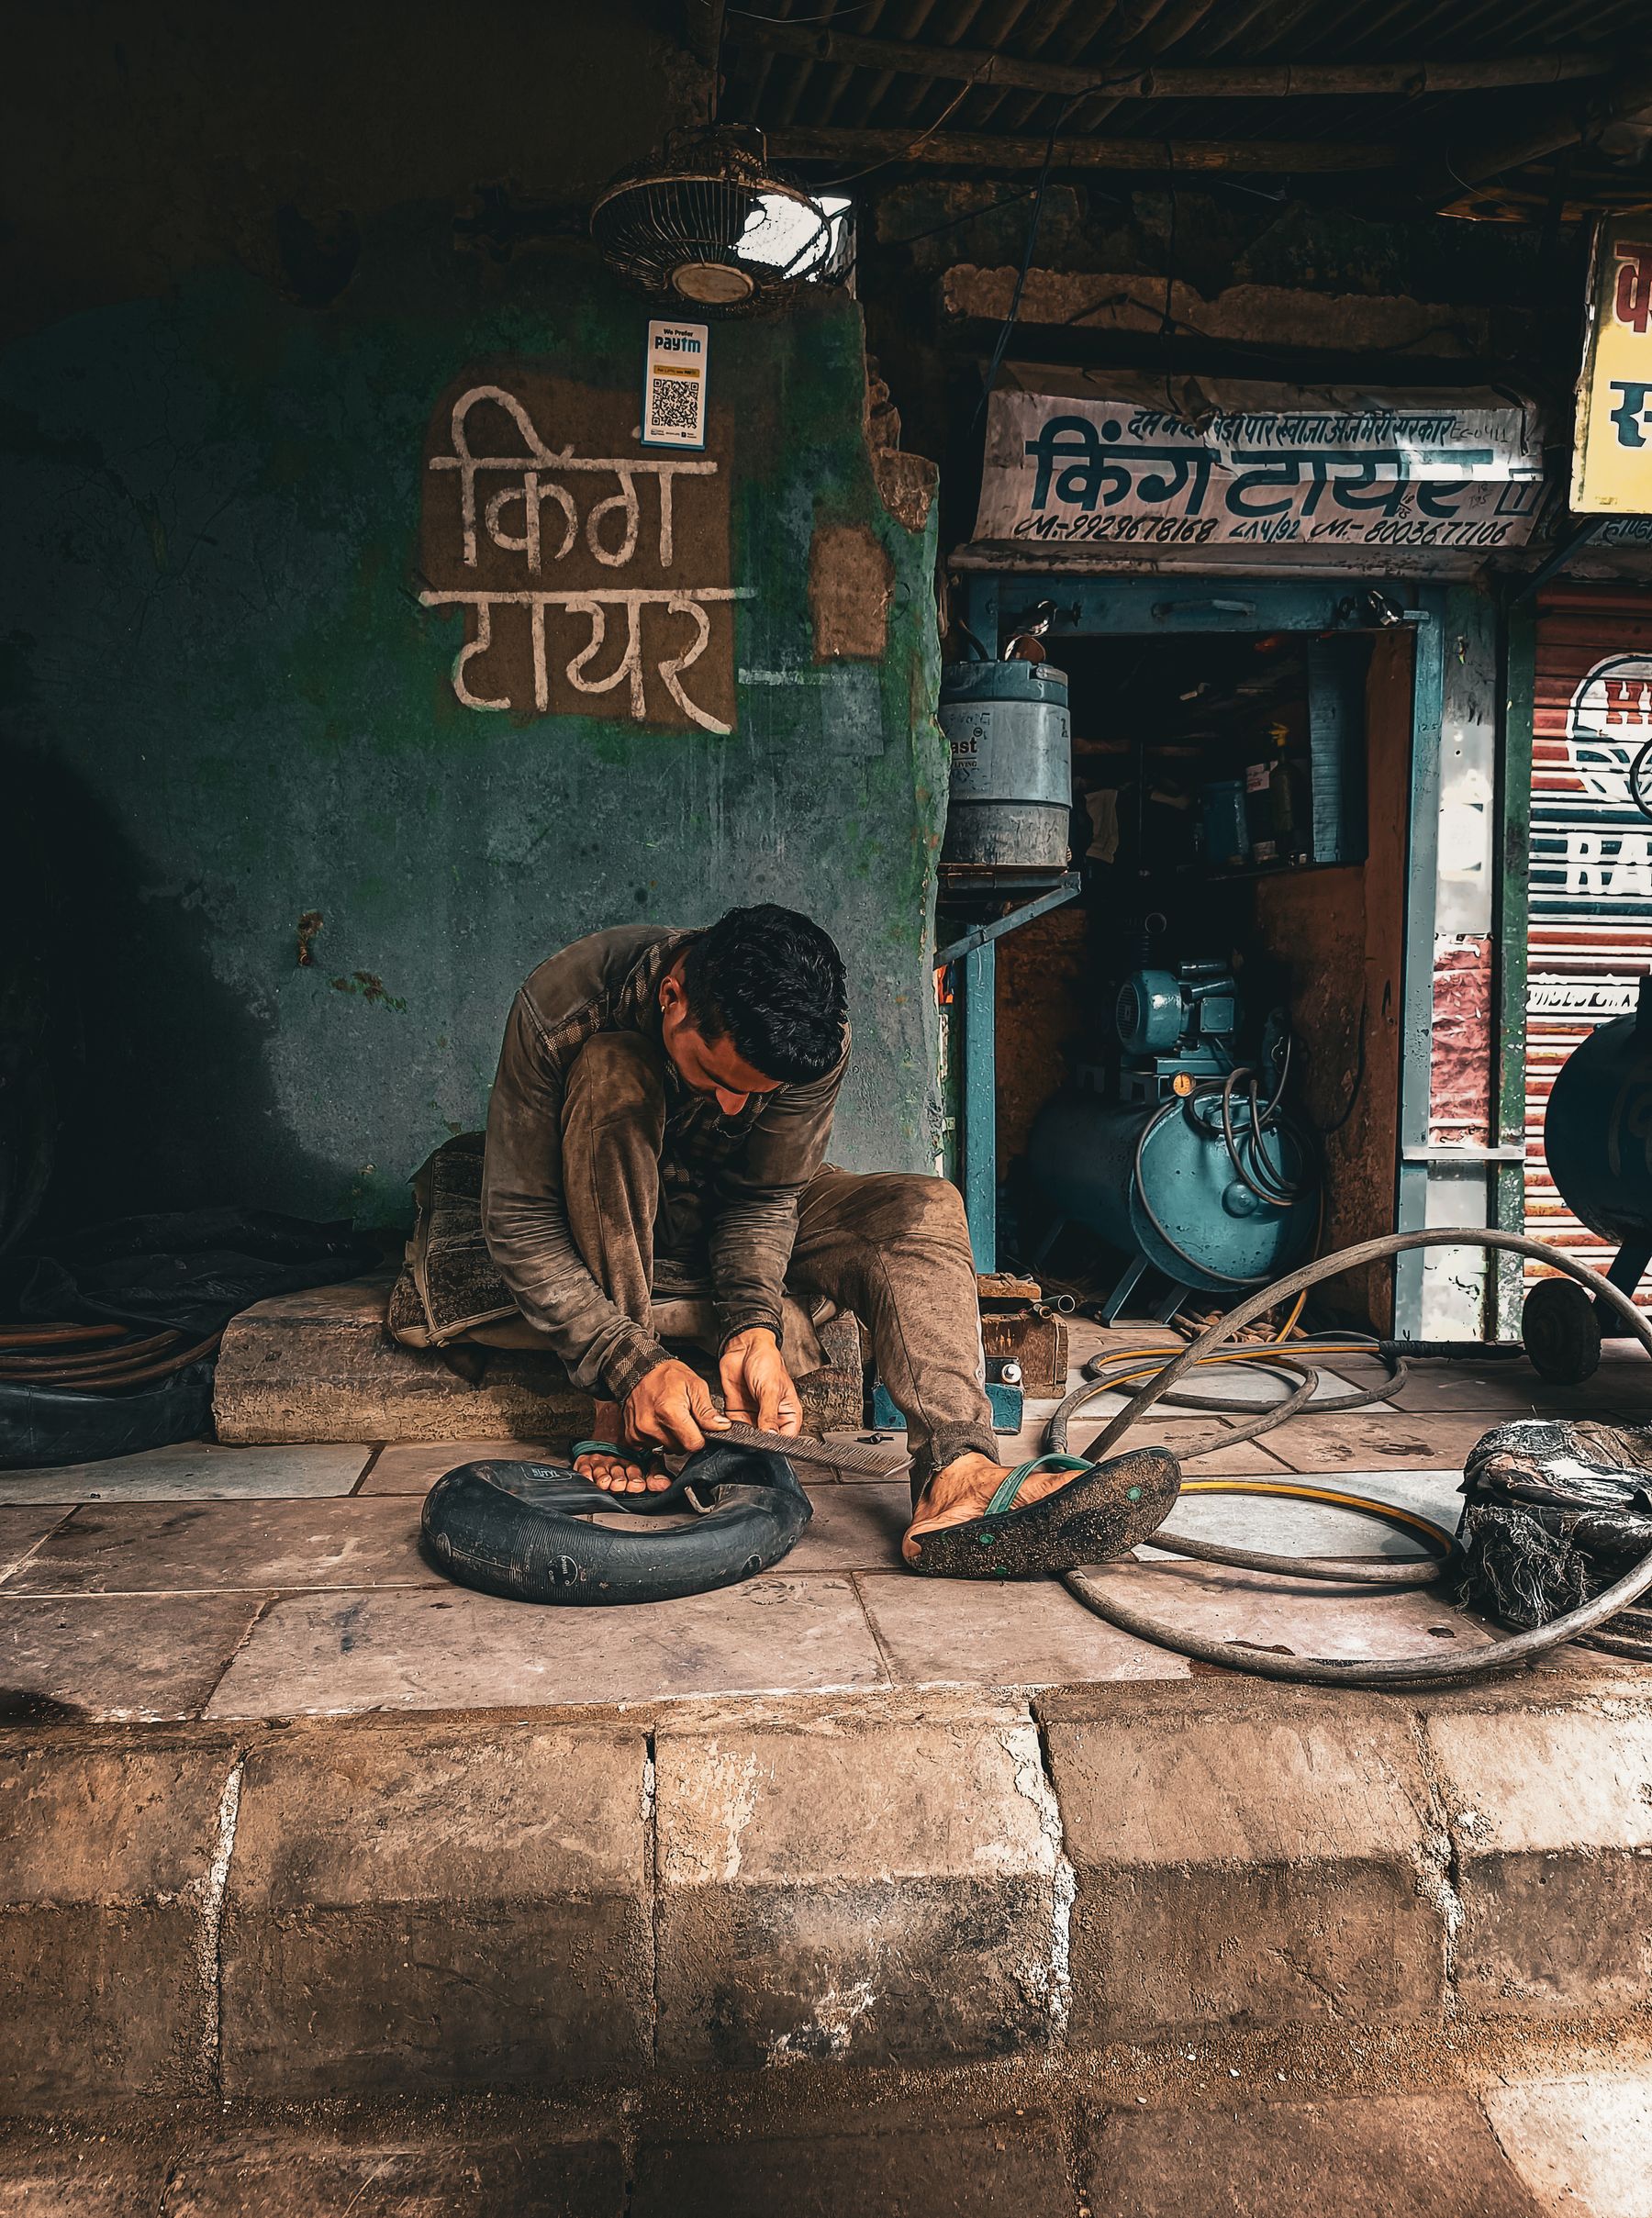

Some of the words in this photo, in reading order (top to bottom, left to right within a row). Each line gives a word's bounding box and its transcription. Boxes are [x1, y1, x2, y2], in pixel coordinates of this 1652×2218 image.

[675, 329, 694, 338] Prefer
[1024, 415, 1222, 515] किंग
[1225, 449, 1493, 518] टायर
[419, 587, 758, 734] टायर
